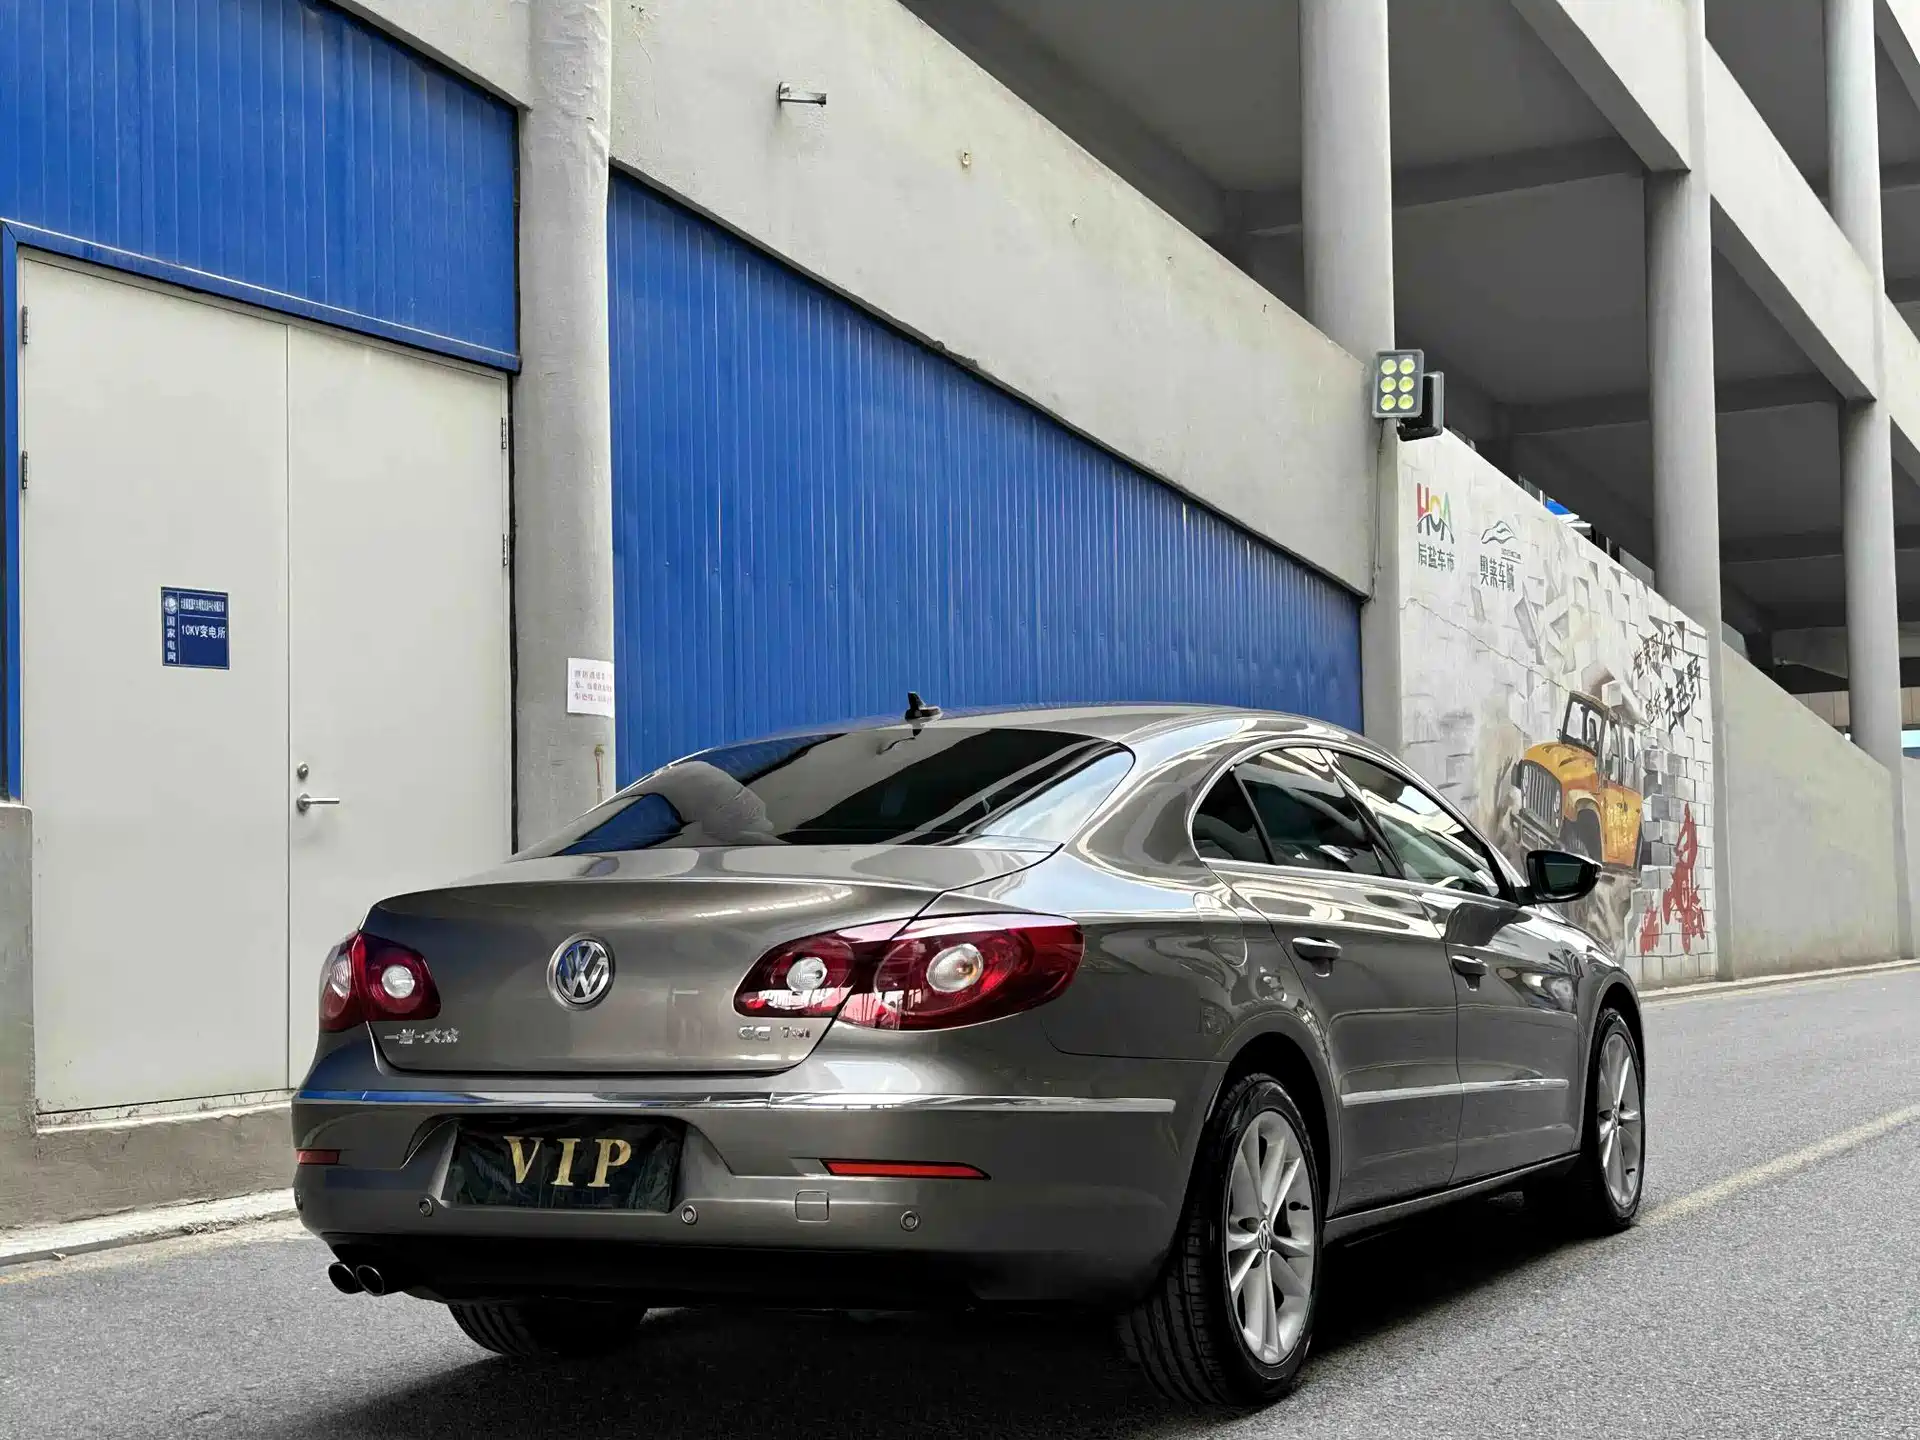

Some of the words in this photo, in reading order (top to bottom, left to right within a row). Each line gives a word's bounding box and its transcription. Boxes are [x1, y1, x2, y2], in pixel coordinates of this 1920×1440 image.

[166, 615, 176, 662] 国家电网
[739, 1026, 771, 1040] CC
[503, 1136, 632, 1187] VIP
